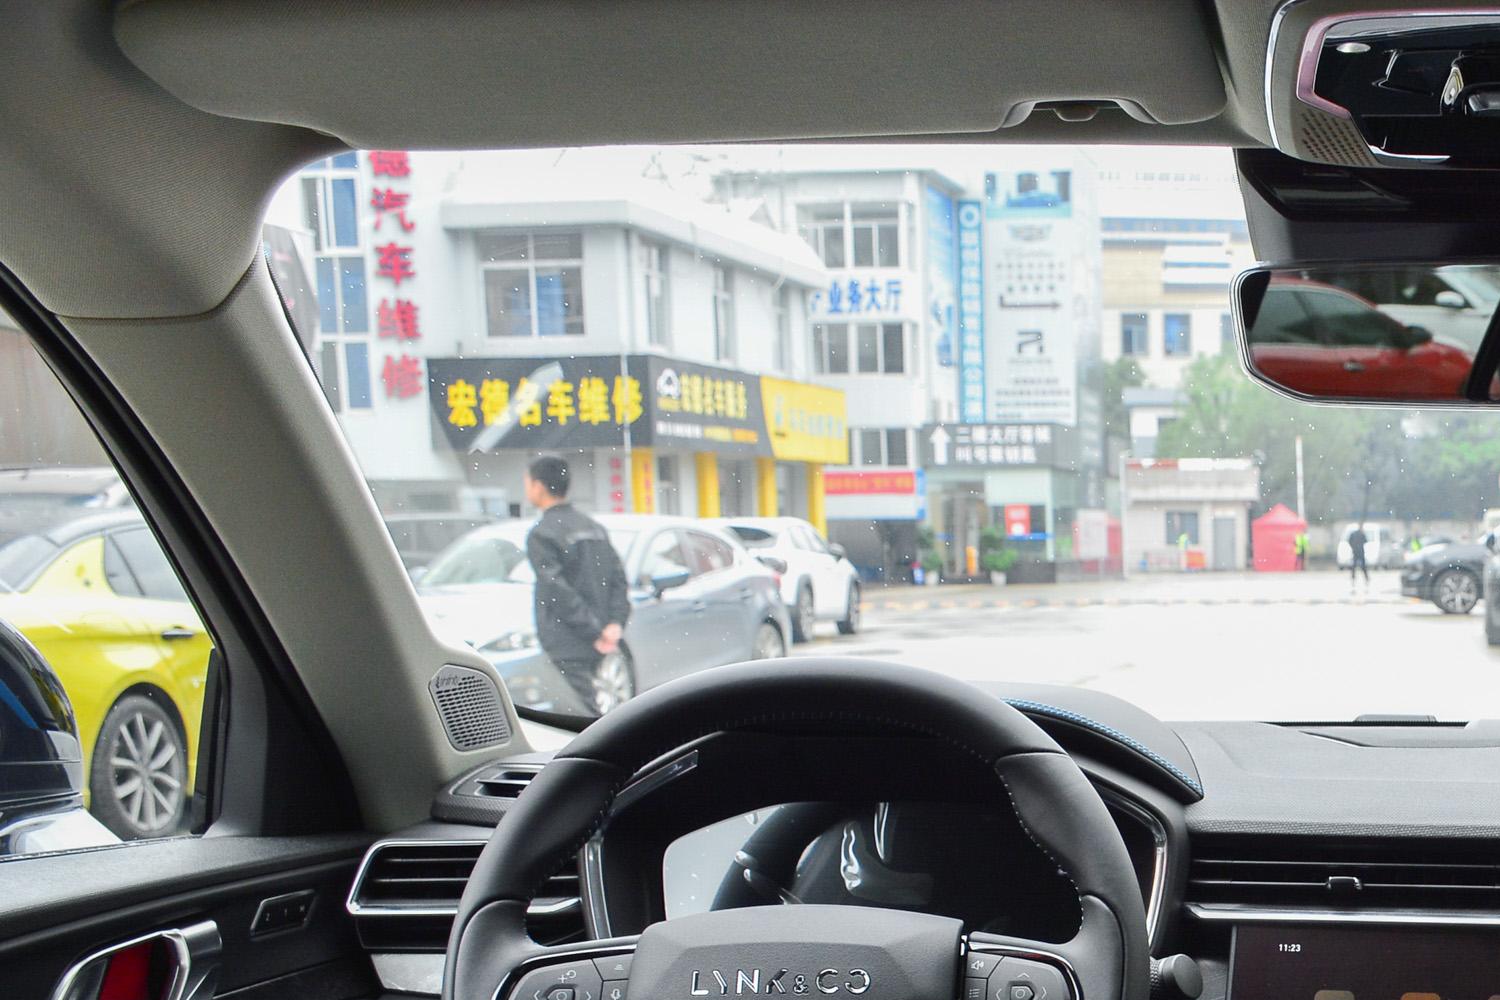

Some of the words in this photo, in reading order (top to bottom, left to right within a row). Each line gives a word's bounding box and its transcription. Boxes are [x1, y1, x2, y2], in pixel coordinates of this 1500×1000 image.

[812, 279, 902, 312] 业务大厅
[1278, 944, 1301, 952] 11:23
